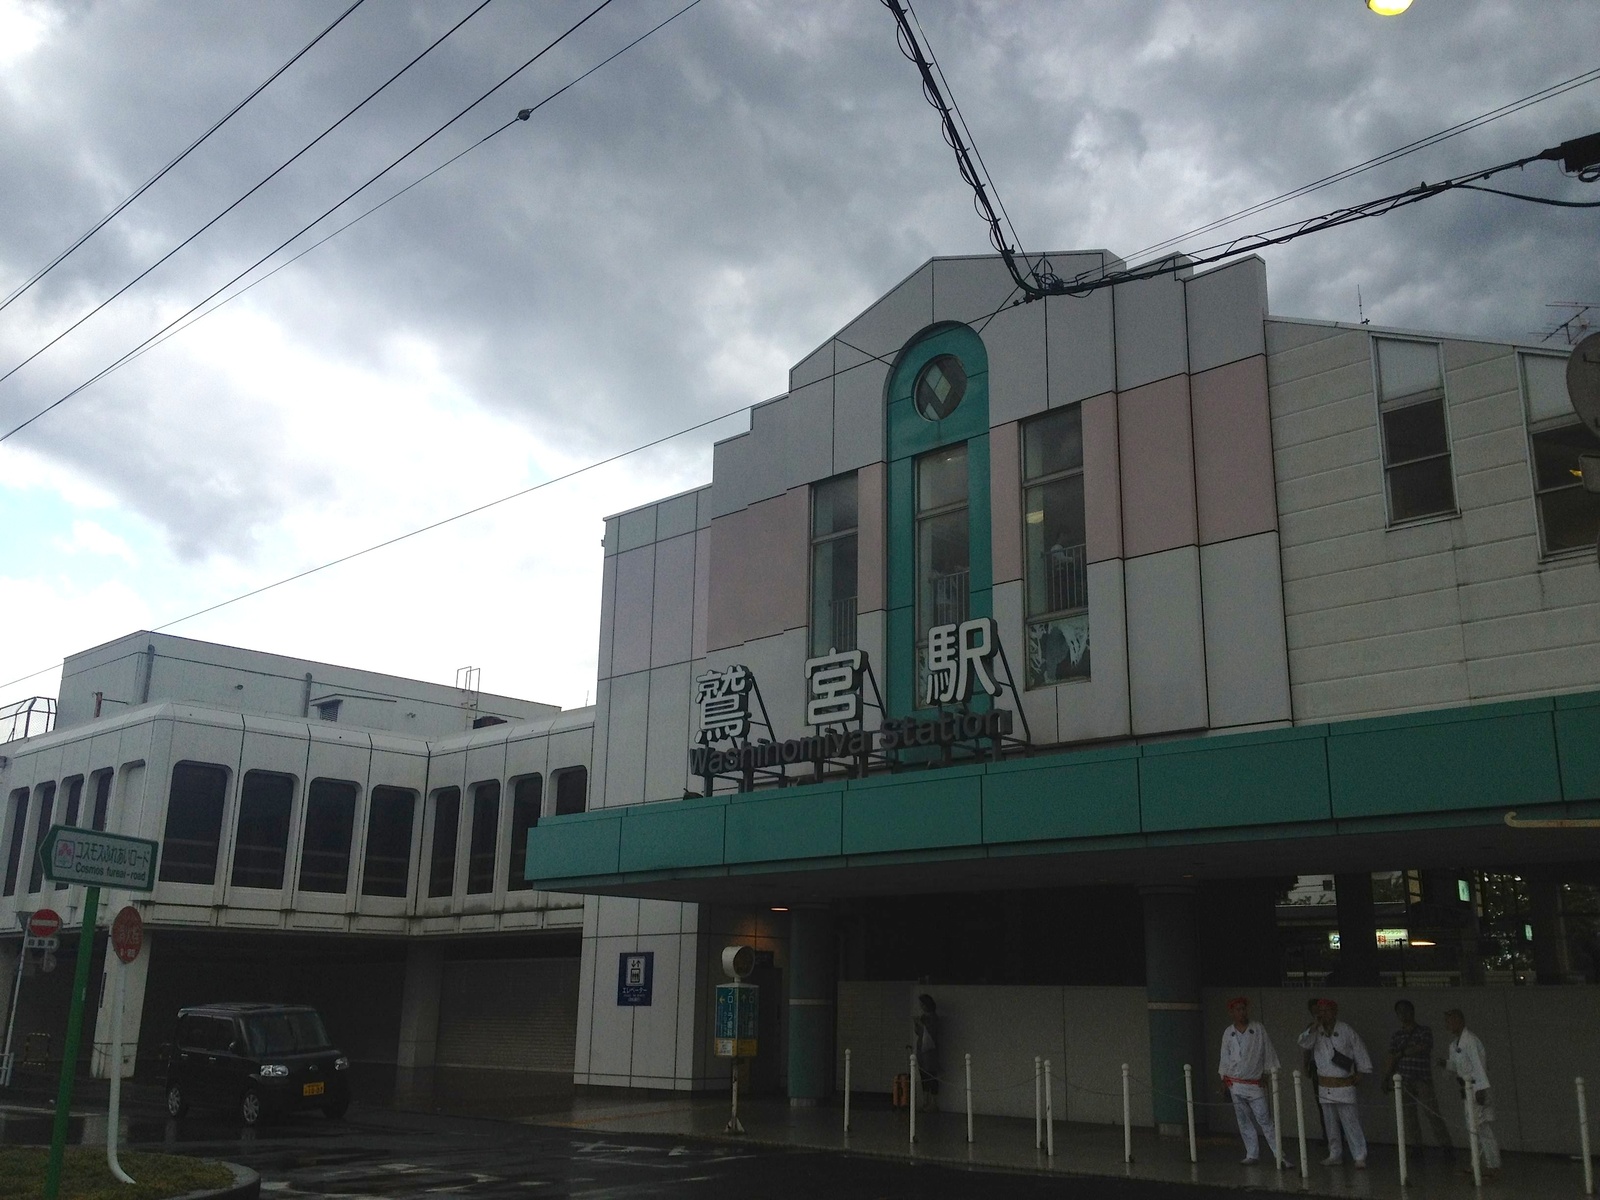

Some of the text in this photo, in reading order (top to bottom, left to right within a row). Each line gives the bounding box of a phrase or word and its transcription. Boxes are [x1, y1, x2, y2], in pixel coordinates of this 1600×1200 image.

[689, 710, 1012, 776] Washinomiya Station
[75, 861, 104, 876] Cosmos
